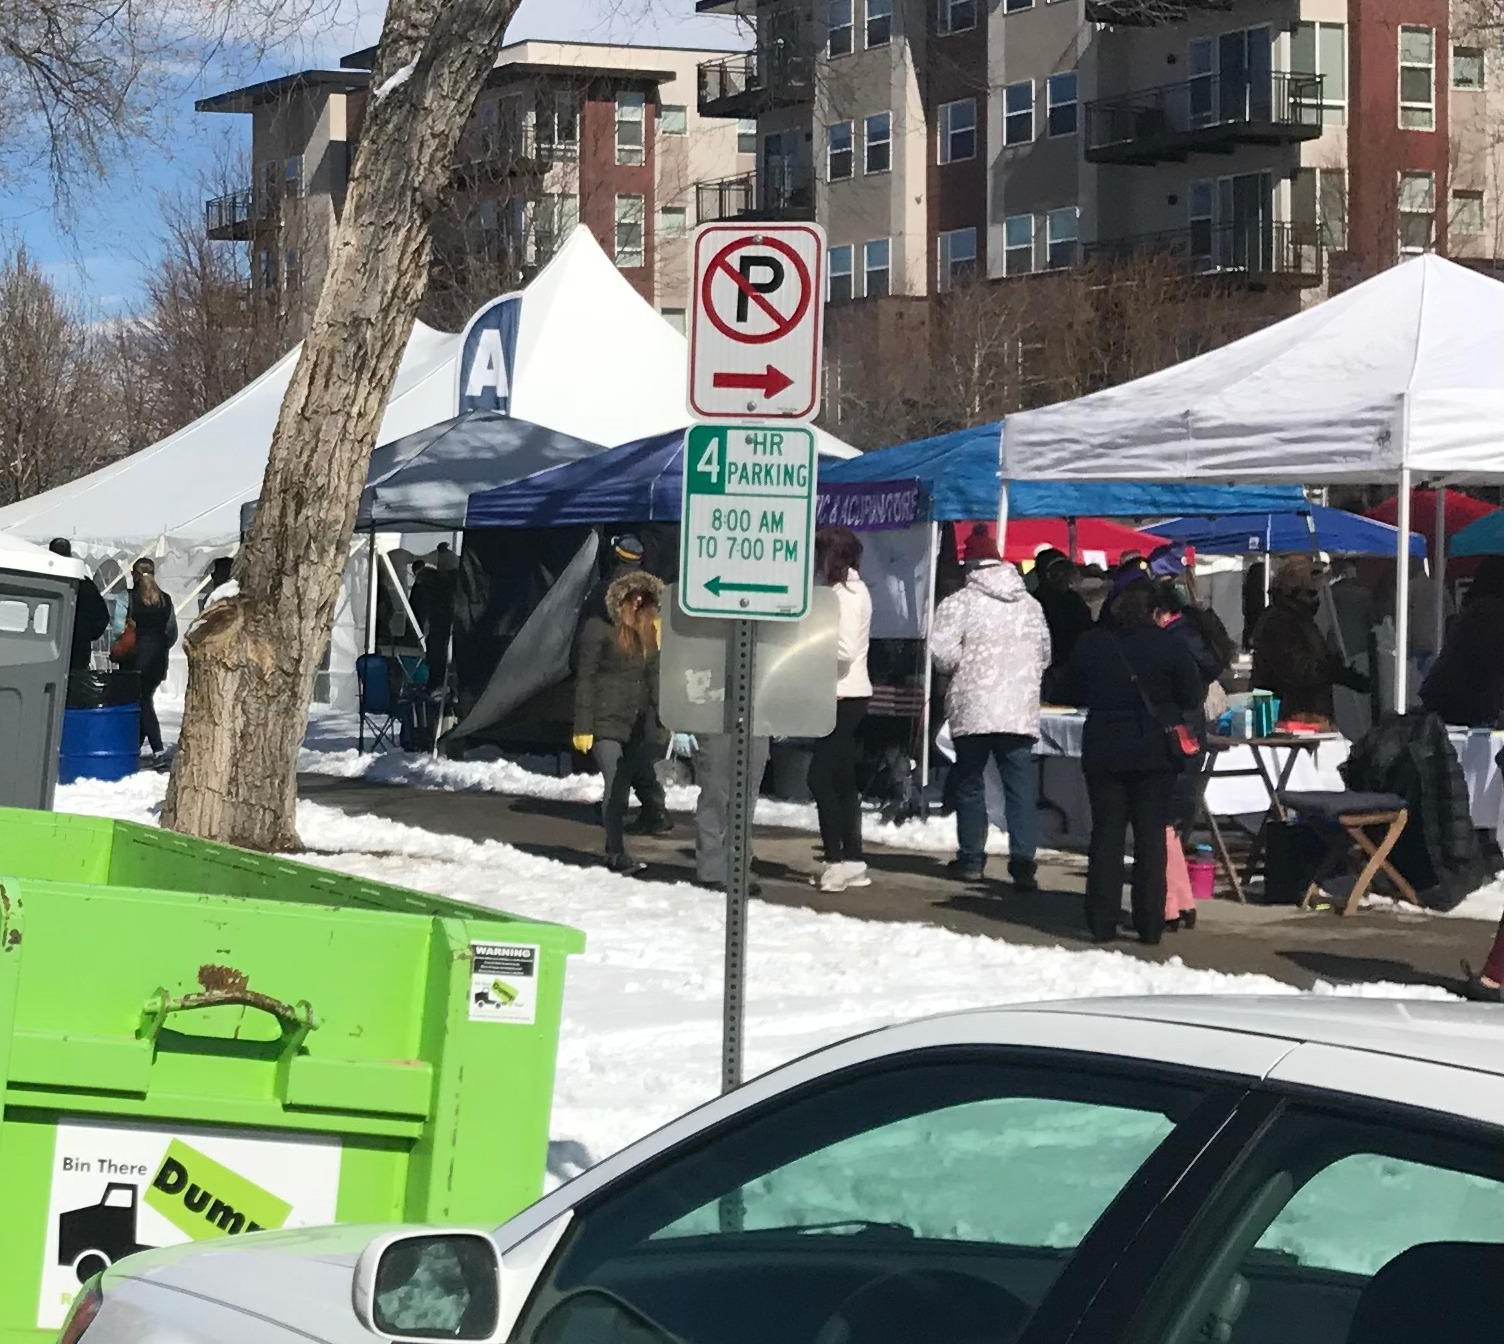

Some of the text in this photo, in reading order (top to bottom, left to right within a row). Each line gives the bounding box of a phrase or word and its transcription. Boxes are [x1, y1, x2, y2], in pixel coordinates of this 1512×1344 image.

[736, 255, 785, 323] P
[696, 432, 784, 484] 4 HR
[727, 461, 808, 488] PARKING
[711, 508, 784, 534] 8:00 AM
[696, 535, 798, 562] TO 7:00 PM
[475, 945, 531, 958] WARNING
[62, 1156, 148, 1176] Bin There
